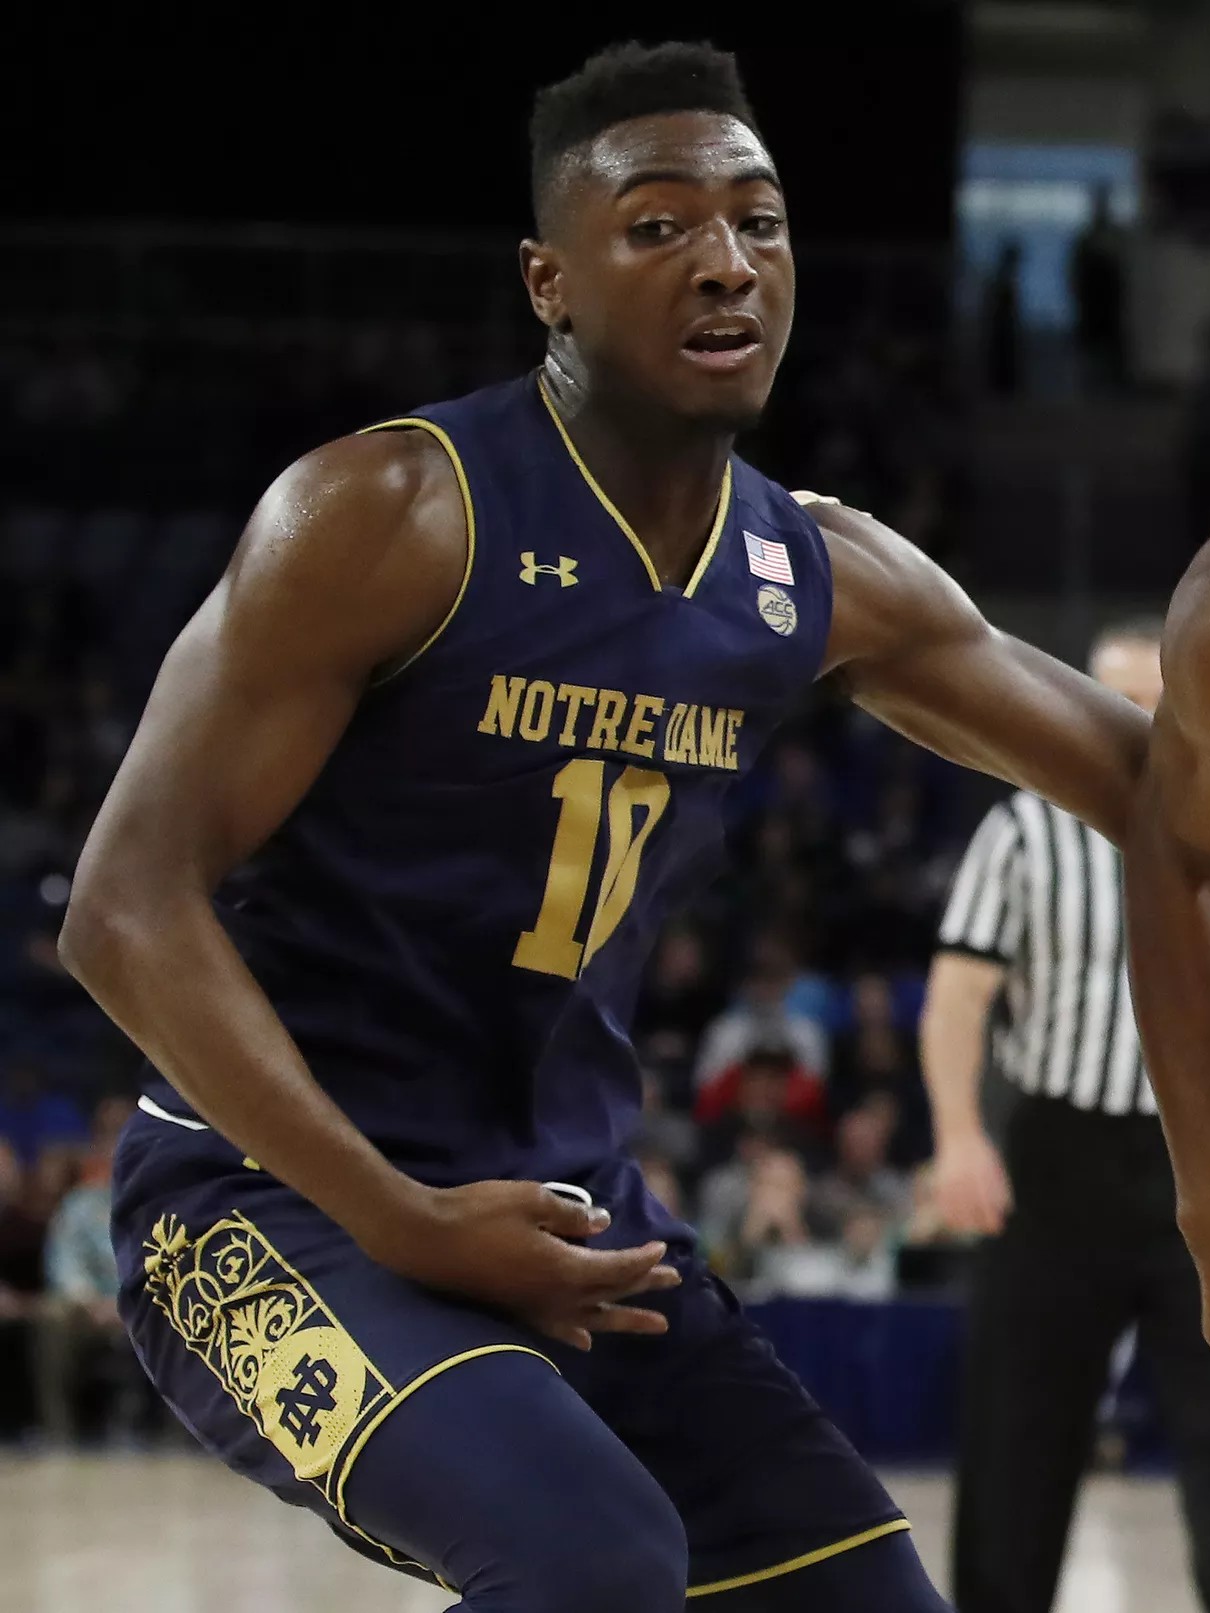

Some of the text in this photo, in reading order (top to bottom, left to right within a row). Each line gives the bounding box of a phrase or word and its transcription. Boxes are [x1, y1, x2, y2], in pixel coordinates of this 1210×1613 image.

[763, 600, 793, 615] ACC
[477, 674, 665, 759] NOTRE
[511, 758, 671, 981] 10
